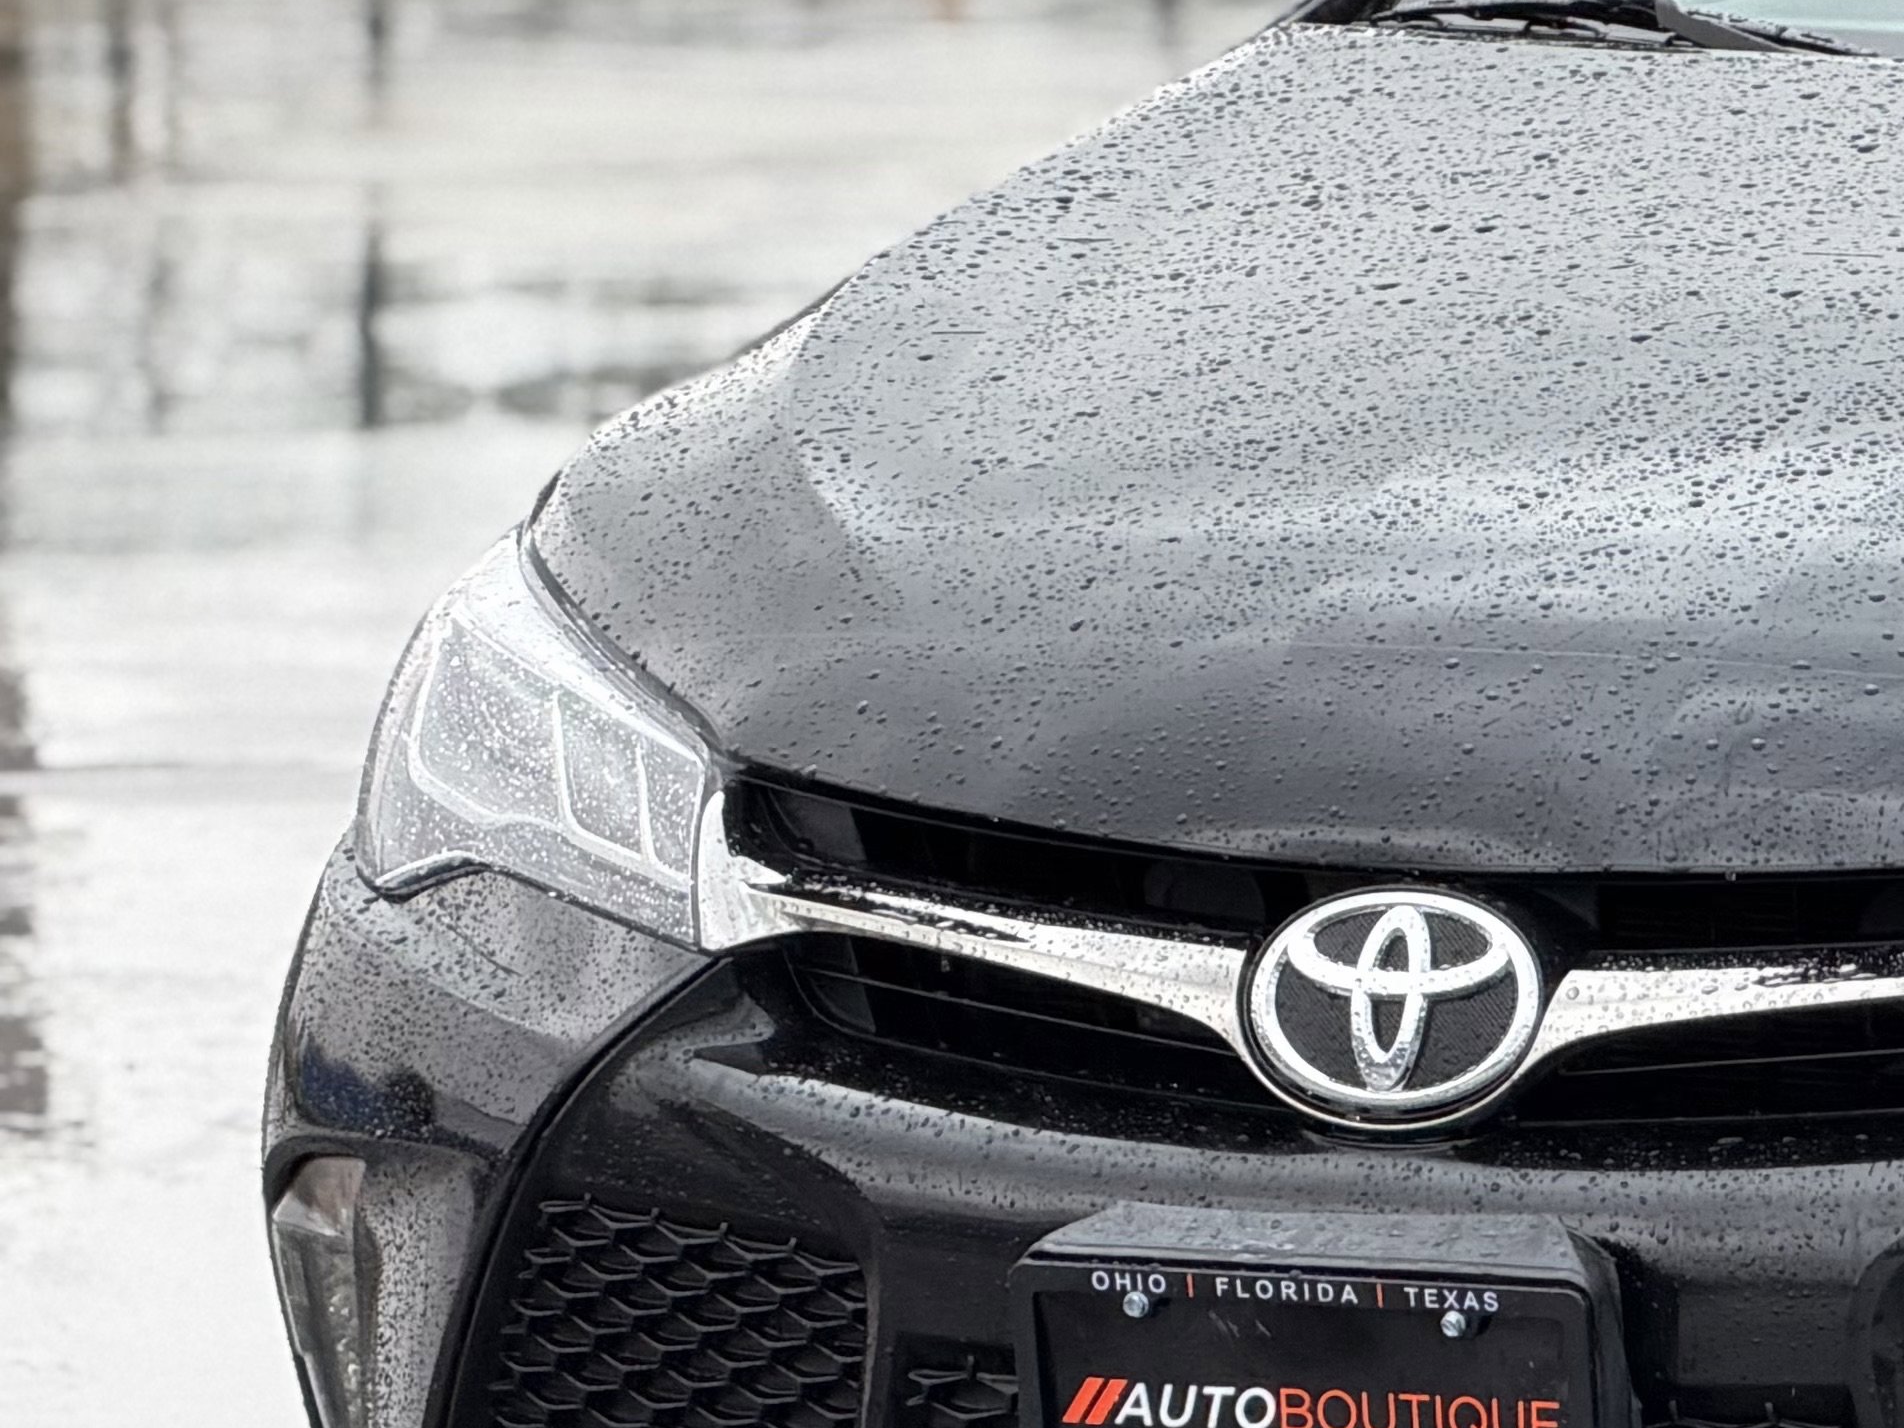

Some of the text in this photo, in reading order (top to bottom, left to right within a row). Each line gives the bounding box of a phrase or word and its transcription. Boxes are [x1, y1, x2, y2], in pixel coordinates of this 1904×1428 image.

[1092, 1271, 1499, 1313] OHIO FLORIDA TEXAS
